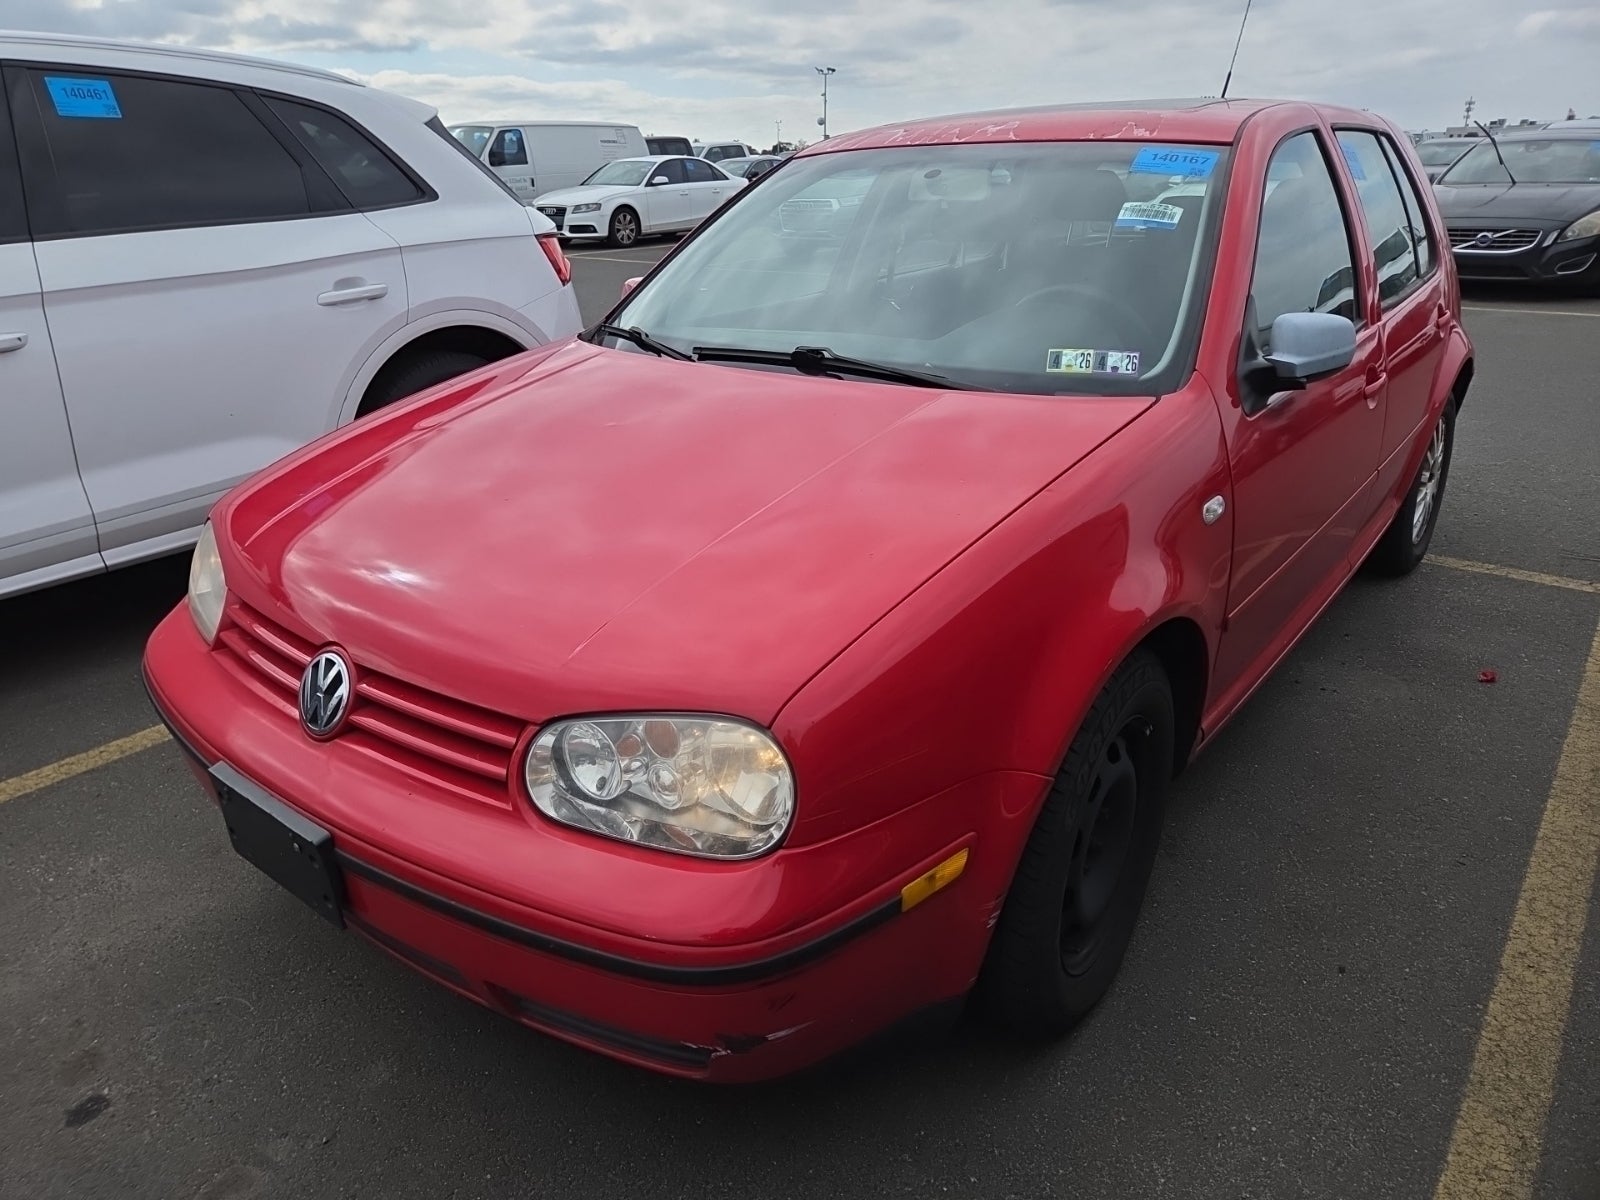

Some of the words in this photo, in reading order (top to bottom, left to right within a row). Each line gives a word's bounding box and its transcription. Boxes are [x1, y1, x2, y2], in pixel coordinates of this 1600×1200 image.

[61, 87, 110, 101] 140461
[1151, 153, 1210, 165] 140167
[1080, 352, 1092, 369] 26
[1125, 354, 1138, 372] 26
